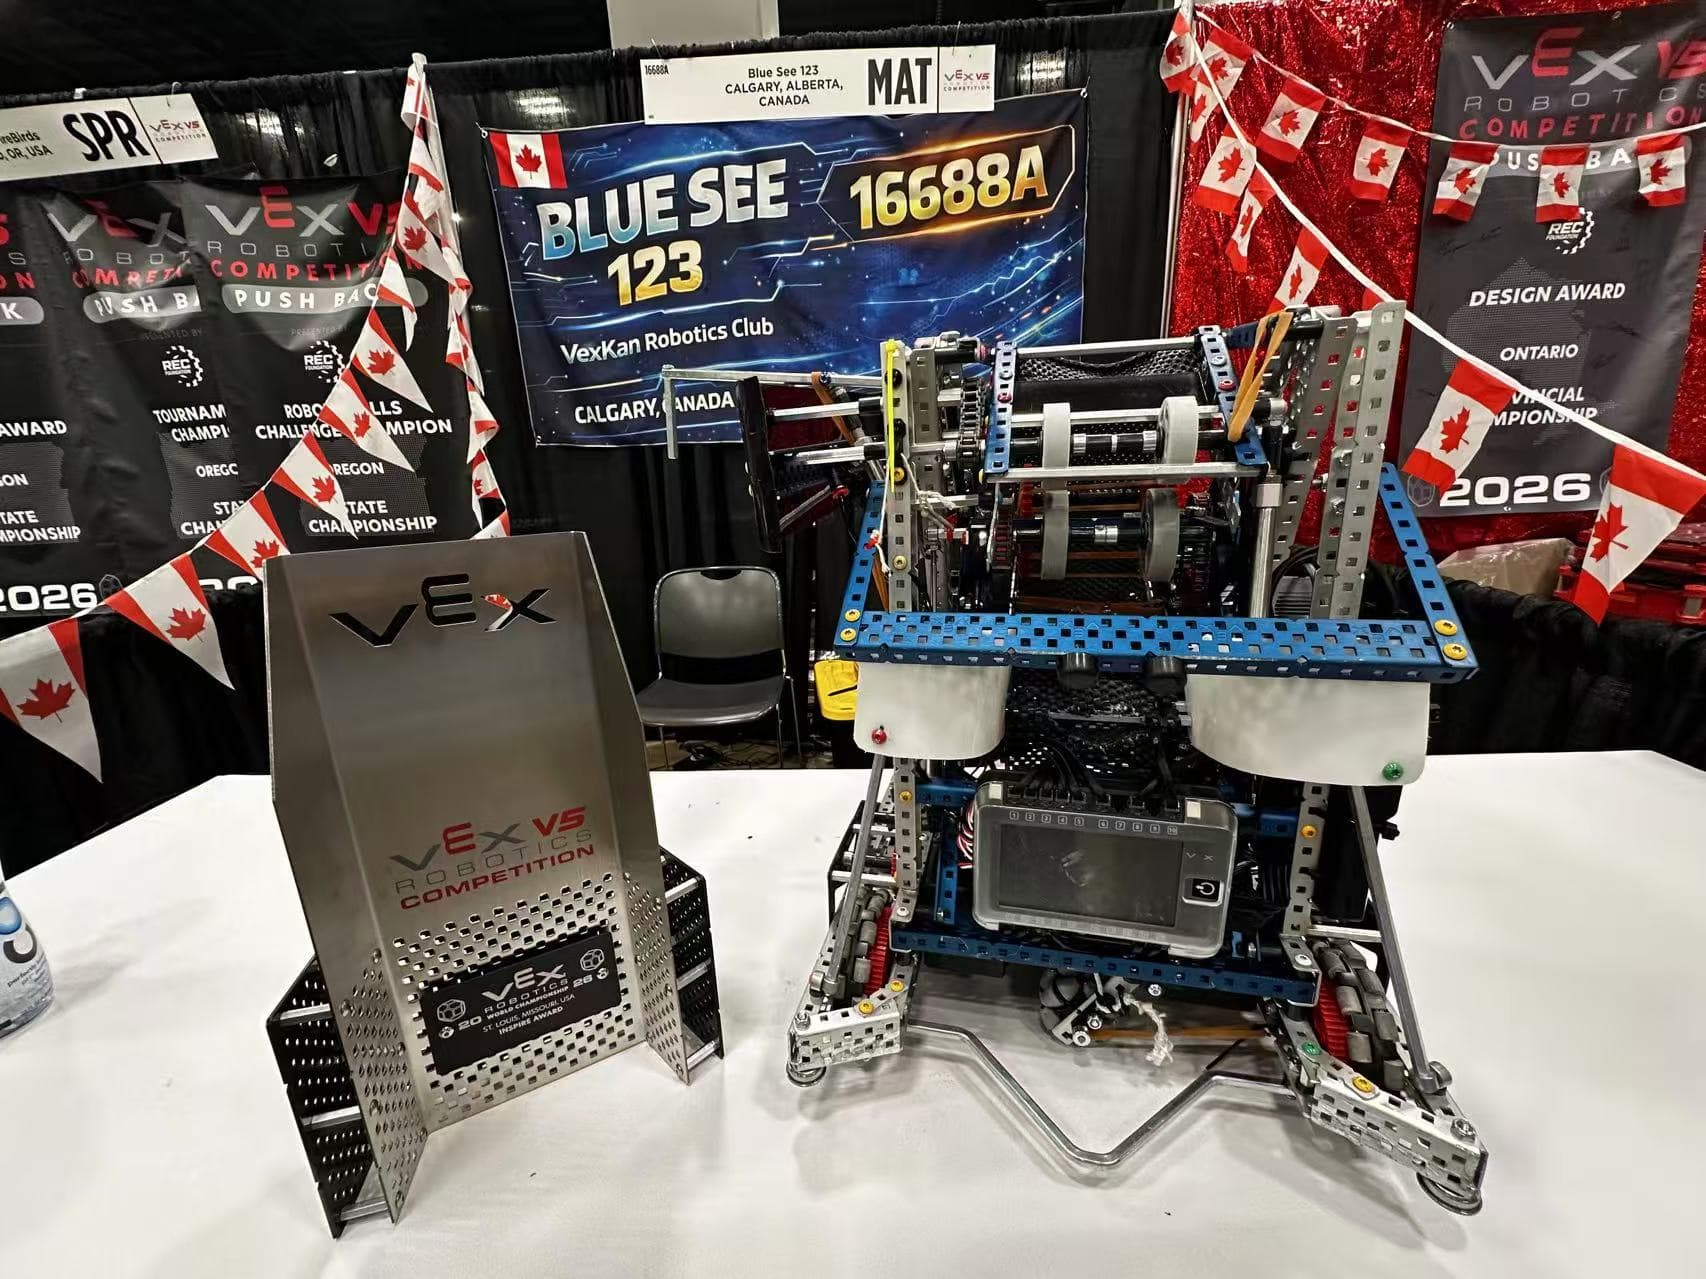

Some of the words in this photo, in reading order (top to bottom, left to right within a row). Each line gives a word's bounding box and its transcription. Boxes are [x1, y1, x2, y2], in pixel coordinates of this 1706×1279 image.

[1472, 27, 1641, 90] VEX
[645, 64, 669, 76] 16688A
[748, 68, 773, 78] Blue
[776, 67, 797, 77] See
[800, 65, 819, 76] 123
[944, 69, 974, 81] VEX
[725, 81, 783, 94] CALGARY,
[786, 79, 843, 91] ALBERTA,
[867, 58, 933, 106] MAT
[759, 94, 810, 106] CANADA
[149, 119, 183, 132] VEX
[0, 130, 41, 144] ireBirds
[62, 110, 151, 161] SPR
[155, 133, 207, 142] COMPETITION
[25, 145, 54, 156] USA
[1586, 148, 1632, 170] BA
[849, 145, 1049, 230] 16688A
[204, 186, 345, 237] VEX
[535, 174, 679, 261] BLUE
[687, 158, 789, 227] SEE
[1548, 221, 1585, 235] REC
[207, 240, 367, 258] ROBOTI
[607, 239, 704, 306] 123
[234, 289, 315, 310] PUSH
[334, 283, 378, 308] BAC
[1469, 286, 1551, 307] DESIGN
[1555, 283, 1626, 301] AWARD
[560, 338, 641, 365] VexKan
[644, 324, 728, 351] Robotics
[731, 317, 774, 337] Club
[304, 354, 334, 366] REC
[1500, 344, 1579, 361] ONTARIO
[162, 358, 191, 371] REC
[152, 404, 227, 424] TOURNAM
[283, 403, 321, 419] ROBO
[369, 400, 403, 415] LLS
[574, 398, 660, 424] CALGARY,
[171, 424, 230, 442] CHAMPI
[386, 419, 453, 435] MPION
[330, 462, 385, 475] REGON
[1439, 472, 1591, 507] 2026
[0, 511, 39, 524] TATE
[0, 526, 81, 543] MPIONSHIP
[0, 583, 97, 612] 026
[328, 573, 558, 648] VEX
[389, 822, 527, 872] VEX
[532, 806, 587, 837] V5
[395, 829, 592, 894] ROBOTICS
[400, 843, 595, 910] COMPETITION
[481, 964, 566, 1001] VEX
[573, 975, 593, 988] 26
[484, 979, 568, 1013] ROBOTICS
[487, 1006, 514, 1019] WORLD
[515, 986, 569, 1009] CHAMPIONSHIP
[560, 994, 575, 1003] USA
[457, 1016, 482, 1030] 20
[499, 1018, 532, 1034] INSPIRE
[533, 1007, 563, 1022] AWARD
